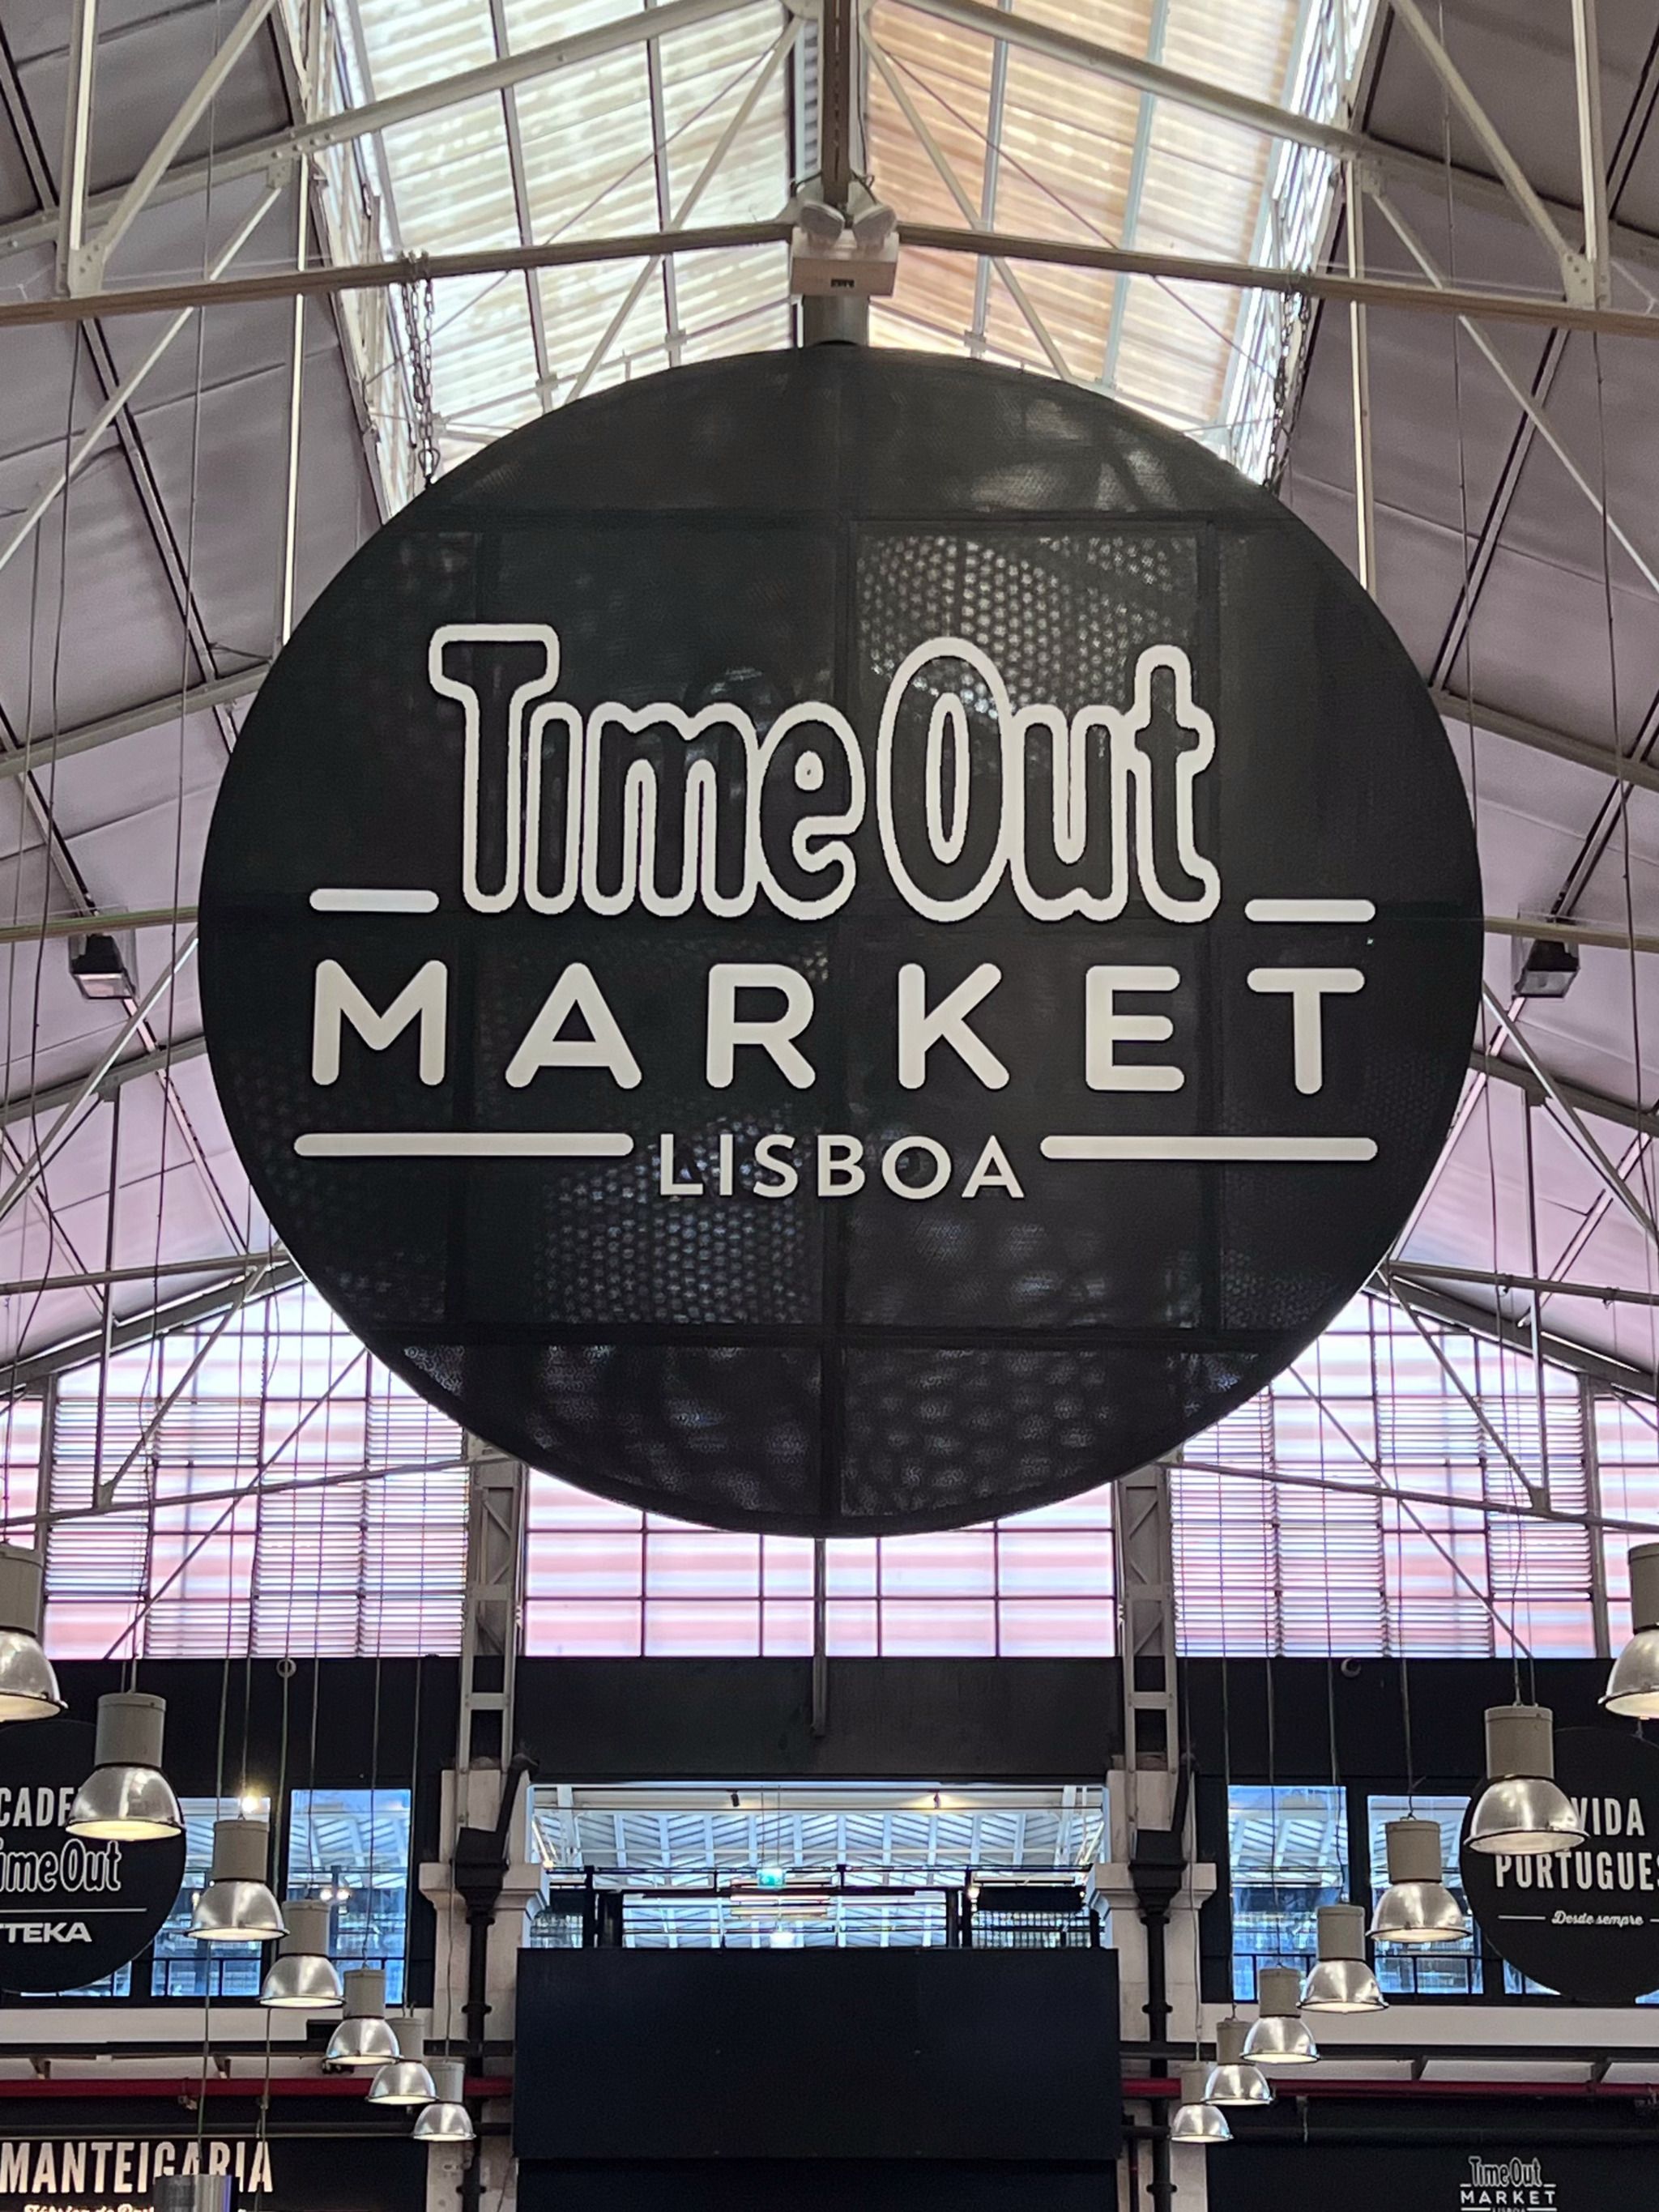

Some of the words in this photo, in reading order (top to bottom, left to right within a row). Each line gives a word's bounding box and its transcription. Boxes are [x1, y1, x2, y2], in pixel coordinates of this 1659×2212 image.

[429, 624, 866, 921] Time
[876, 636, 1221, 923] Out
[310, 959, 1367, 1095] MARKET
[658, 1133, 1026, 1200] LISBOA
[0, 1787, 80, 1827] CADE
[1570, 1796, 1645, 1836] VIDA
[60, 1838, 122, 1892] Out
[1495, 1850, 1659, 1890] PORTUGUE
[1551, 1910, 1595, 1924] Desde
[1596, 1914, 1644, 1929] sempre
[0, 2142, 274, 2193] MANTEIGARIA
[1468, 2155, 1509, 2188] Time
[1509, 2156, 1543, 2188] Out
[1460, 2189, 1556, 2205] MARKET
